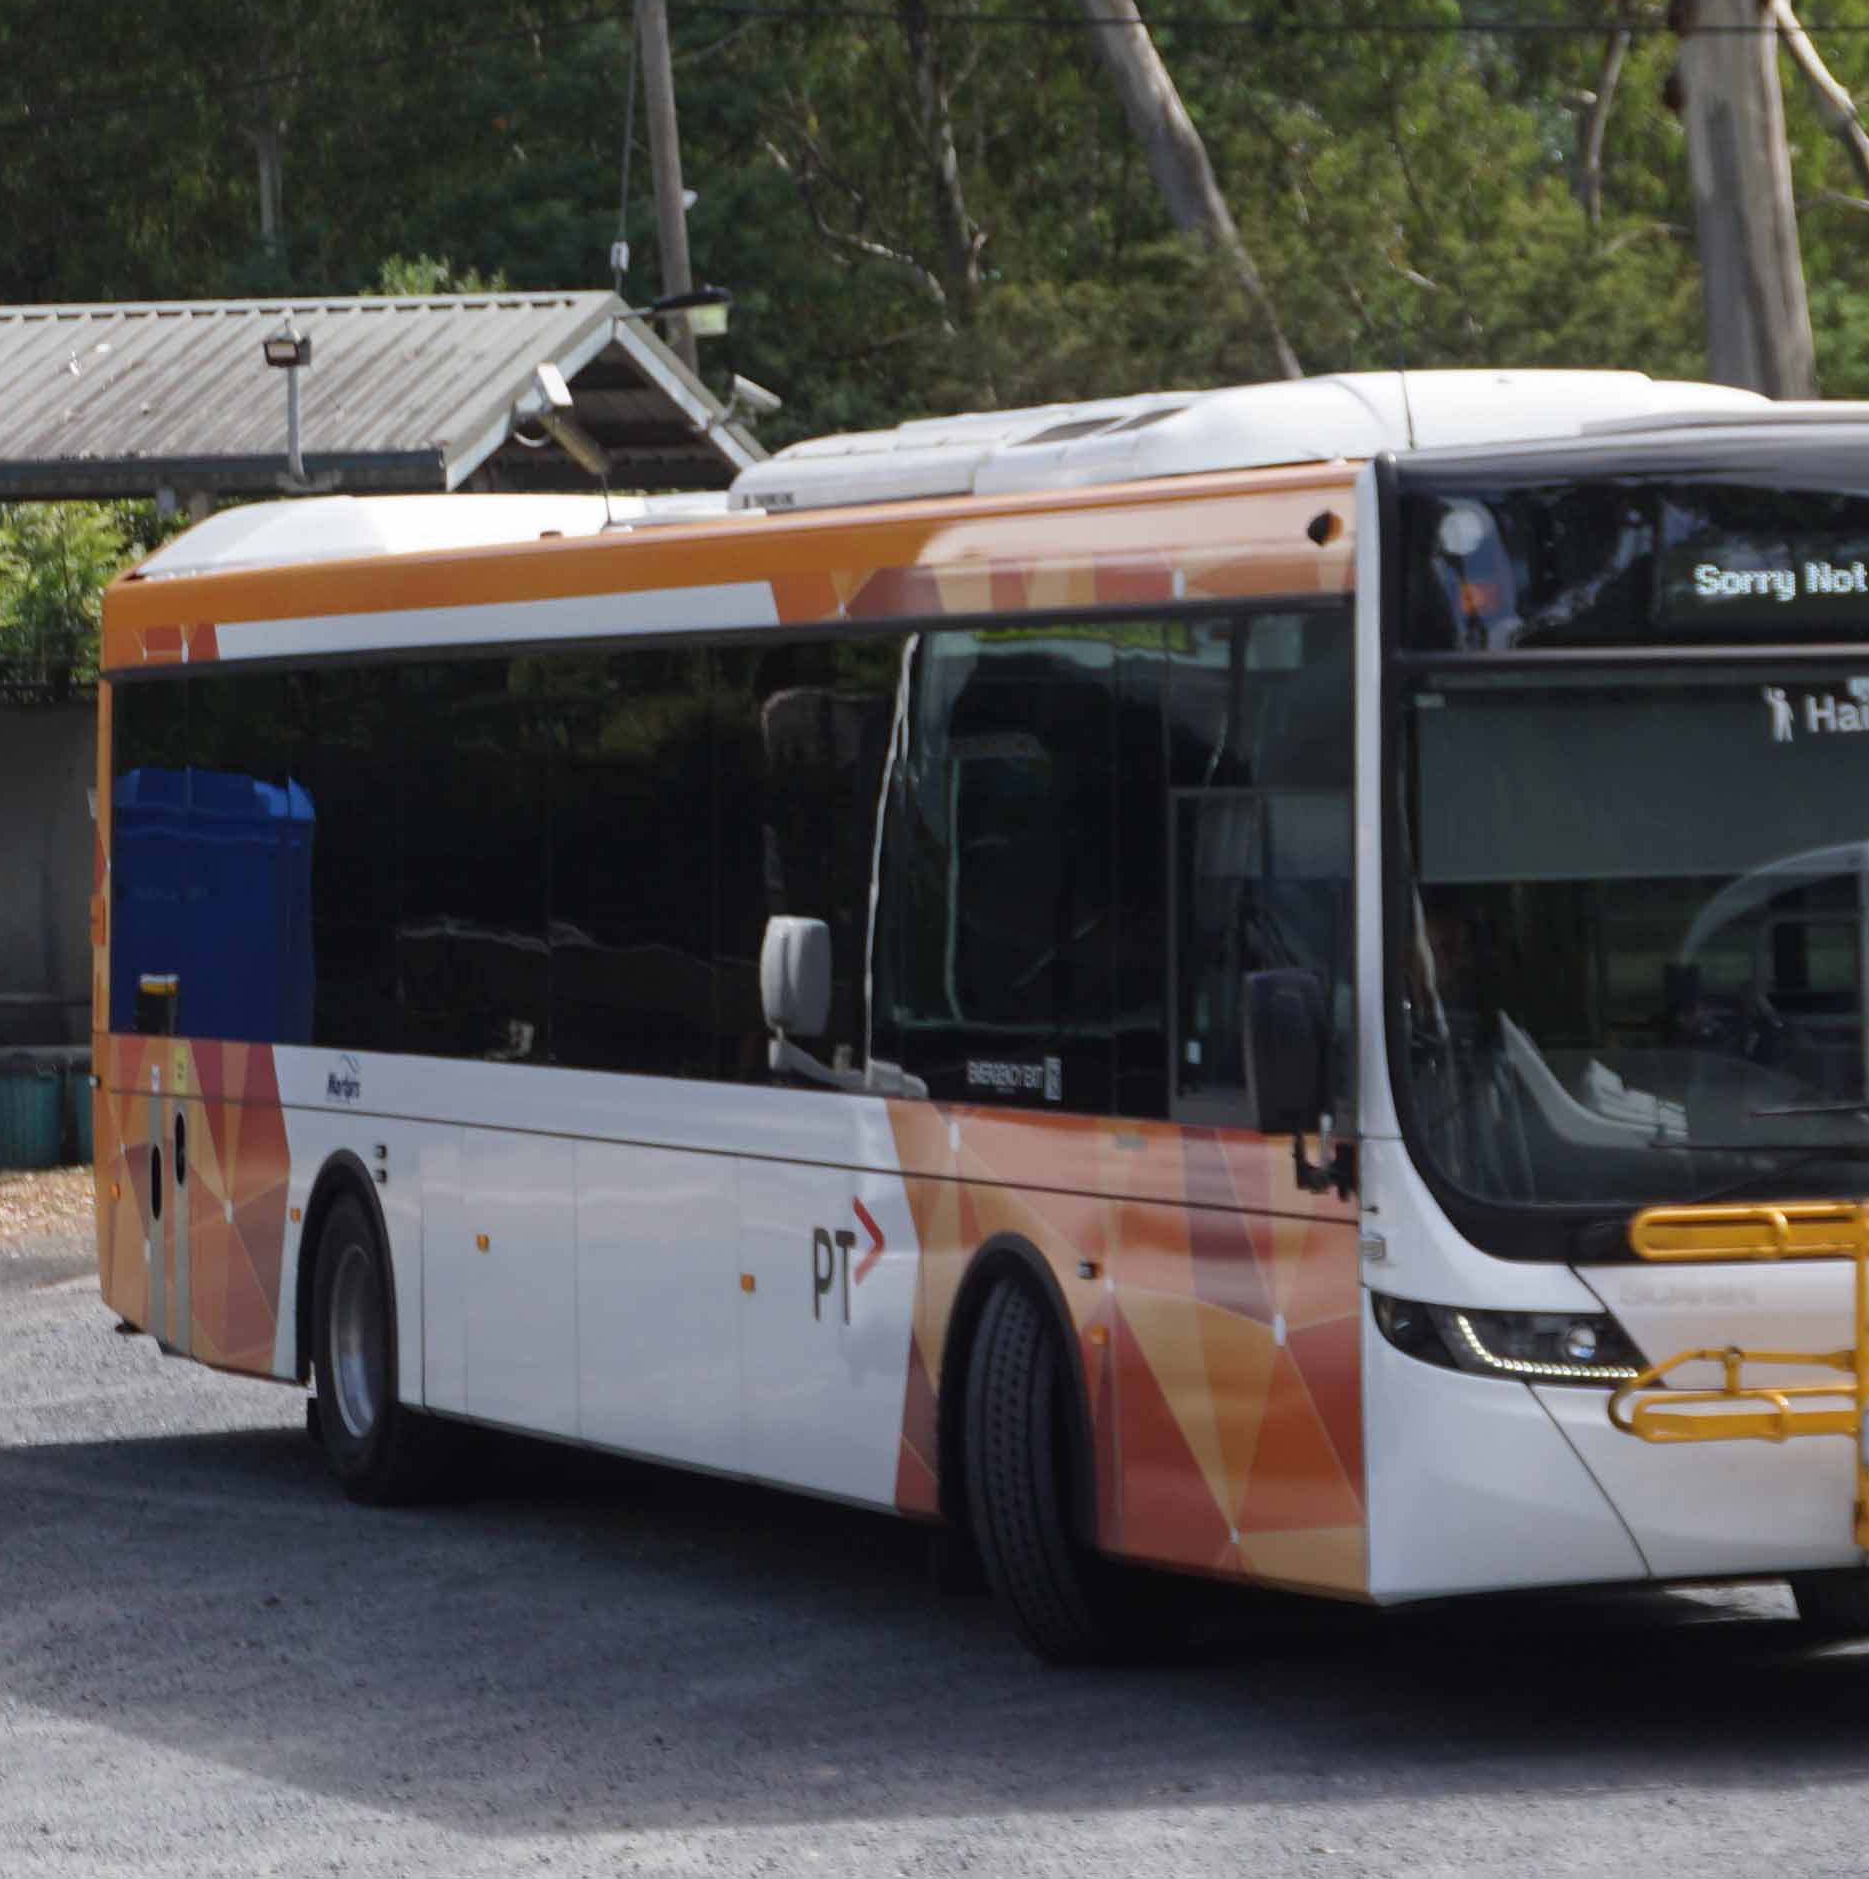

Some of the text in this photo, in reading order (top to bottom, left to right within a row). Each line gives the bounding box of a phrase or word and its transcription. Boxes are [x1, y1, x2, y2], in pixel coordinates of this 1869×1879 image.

[1694, 563, 1796, 601] Sorry
[1804, 561, 1869, 593] Not
[813, 1226, 856, 1326] PT
